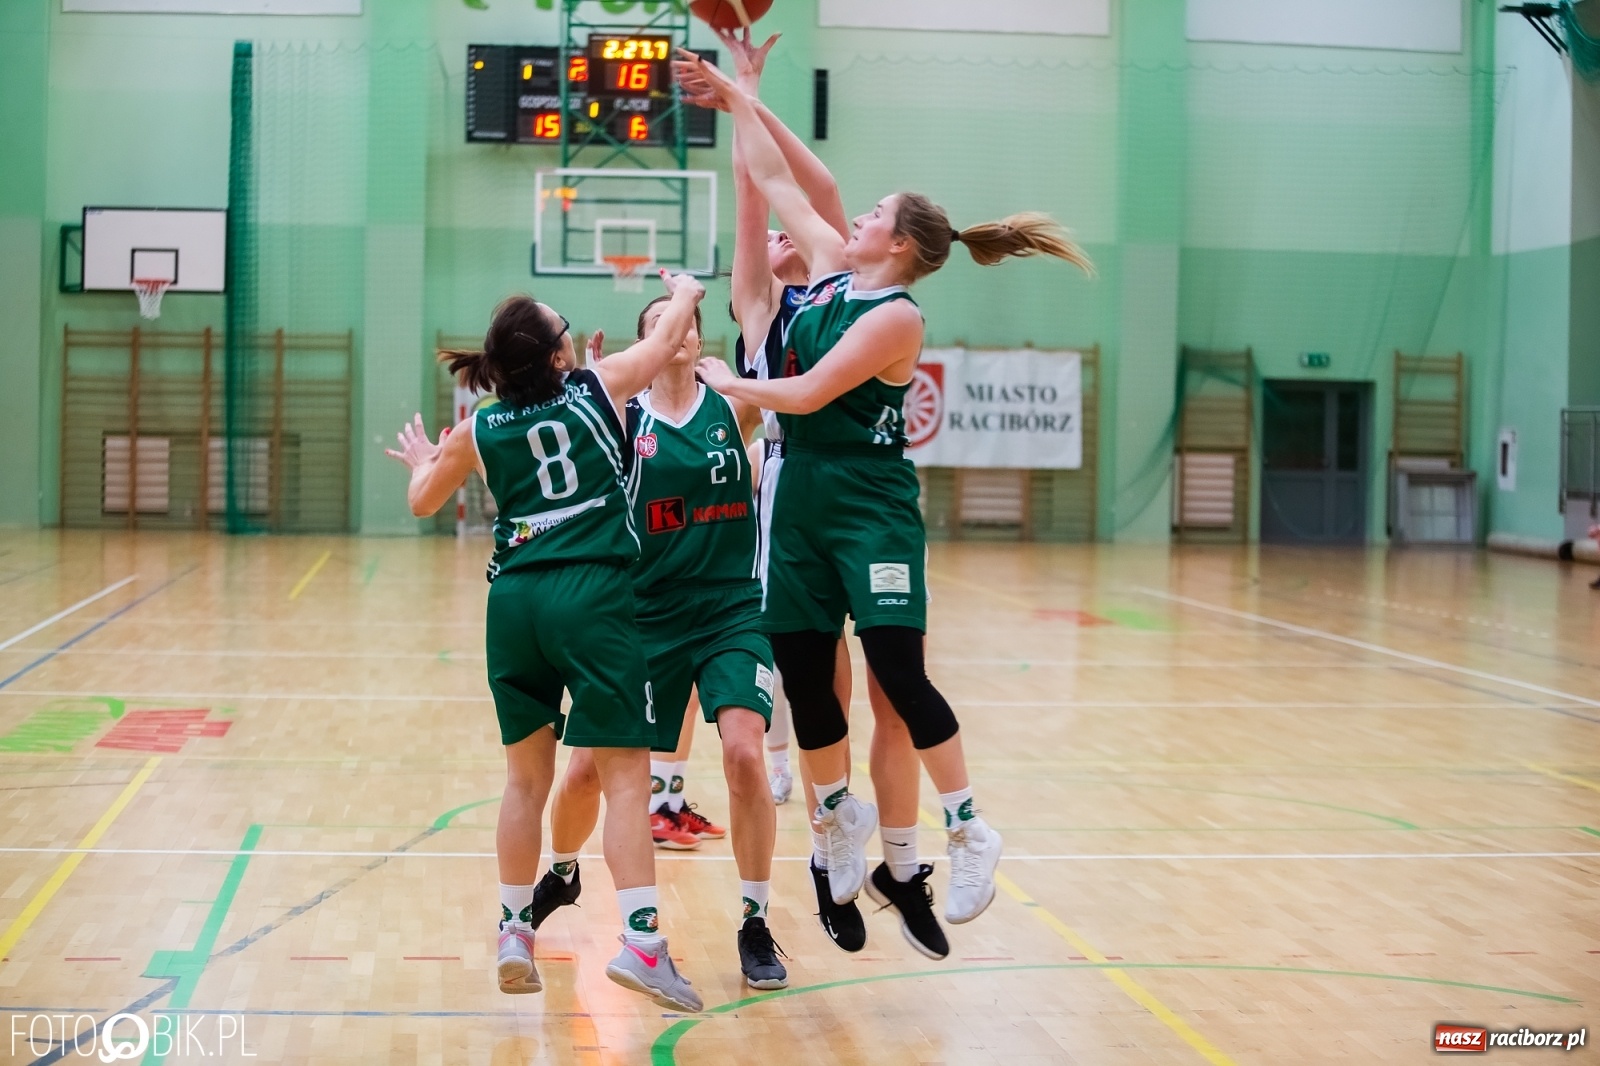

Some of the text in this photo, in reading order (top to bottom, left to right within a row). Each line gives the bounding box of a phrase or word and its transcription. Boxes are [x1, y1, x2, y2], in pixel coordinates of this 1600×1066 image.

[617, 63, 650, 89] 16
[534, 113, 561, 138] 15
[965, 384, 1057, 404] MIASTO
[950, 408, 1074, 434] RACIBÓRZ
[527, 420, 579, 500] 8
[706, 448, 742, 485] 27
[650, 502, 747, 530] K KAMAN
